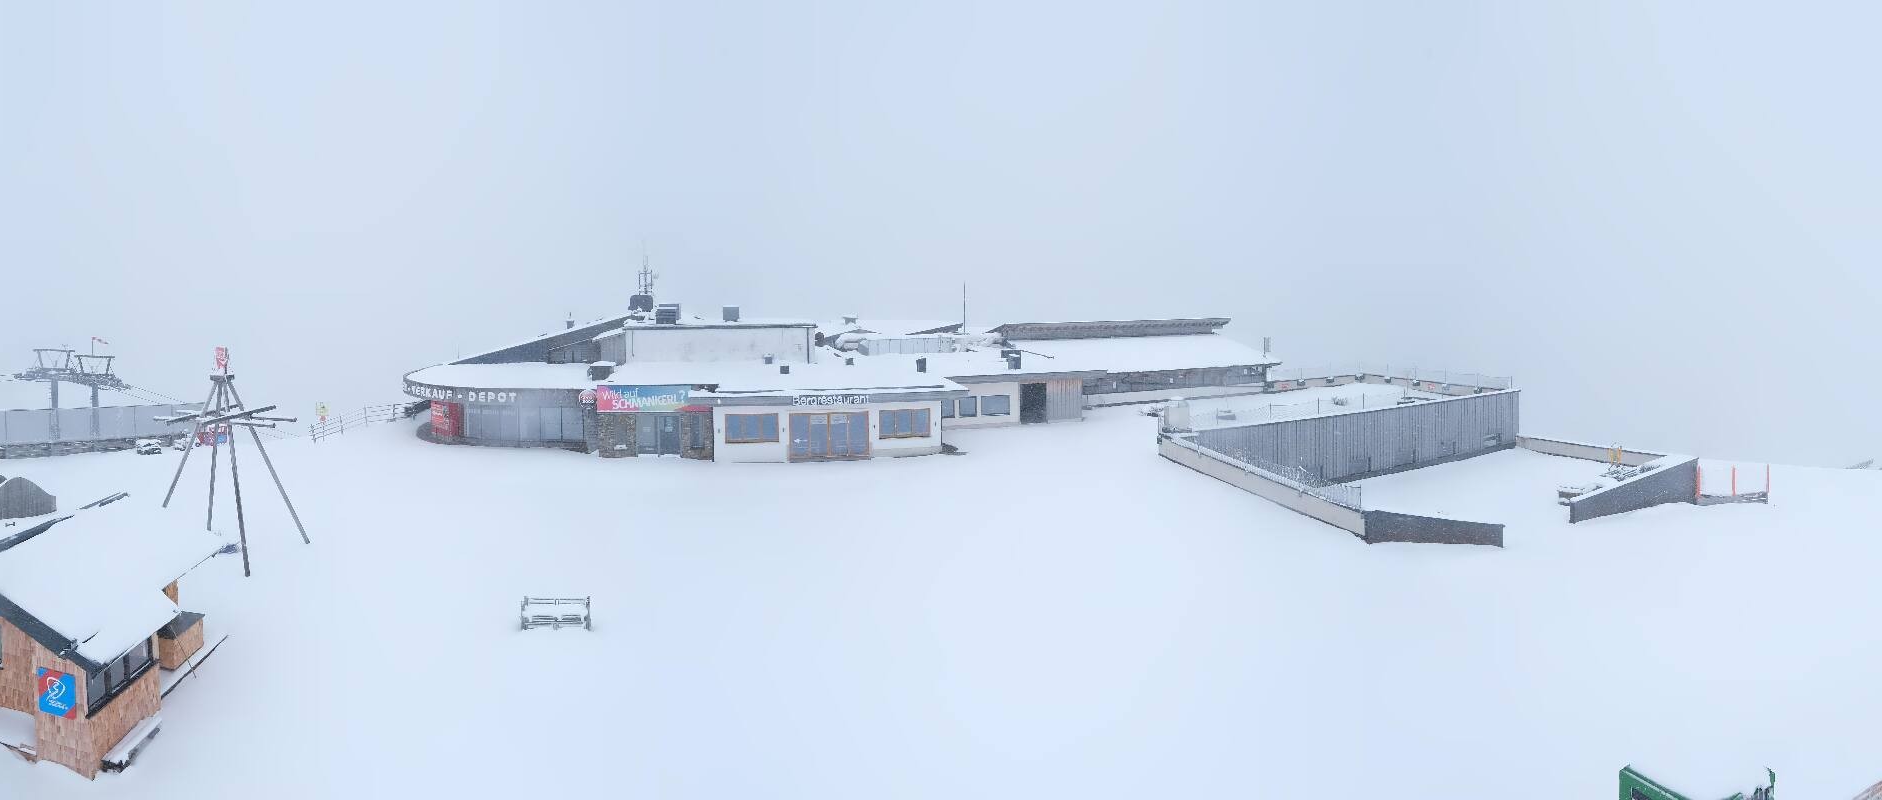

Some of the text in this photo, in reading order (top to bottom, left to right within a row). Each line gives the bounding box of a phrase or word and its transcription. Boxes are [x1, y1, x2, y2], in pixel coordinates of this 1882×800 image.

[468, 391, 516, 403] DEPOT
[601, 388, 622, 400] Wild
[623, 387, 639, 398] auf
[792, 394, 869, 406] Bergrestaurant
